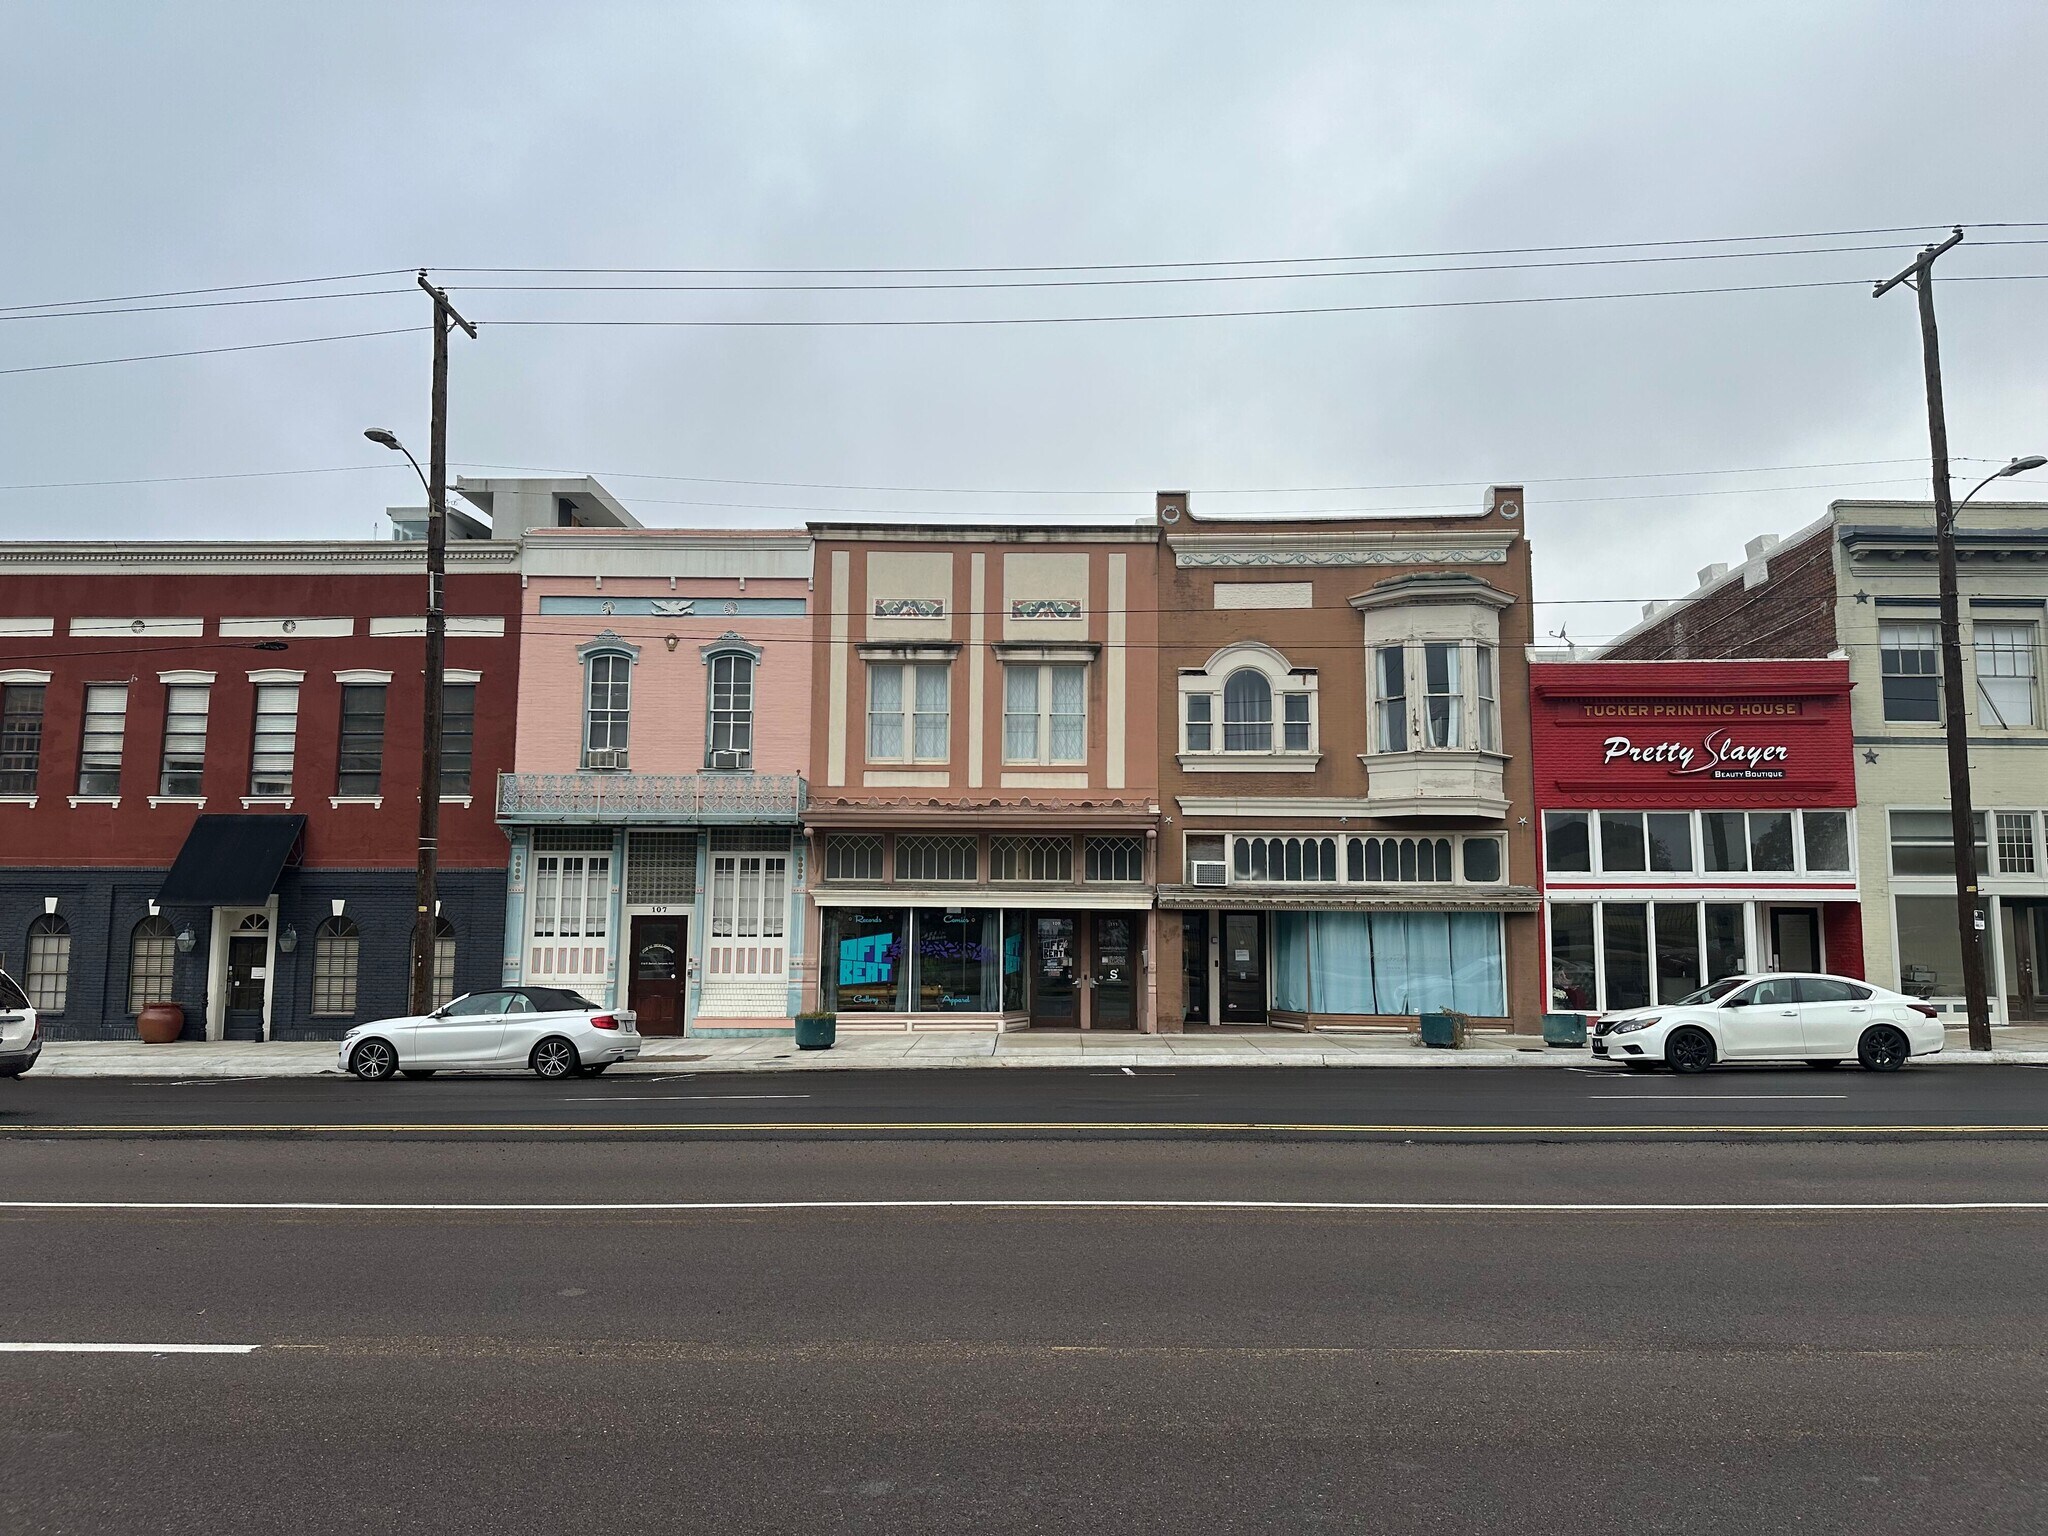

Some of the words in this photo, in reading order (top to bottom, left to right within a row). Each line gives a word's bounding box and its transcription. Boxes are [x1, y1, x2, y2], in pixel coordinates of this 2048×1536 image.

[1584, 705, 1649, 716] TUCKER
[1654, 704, 1735, 716] PRINTING
[1739, 703, 1796, 715] HOUSE
[1603, 736, 1695, 769] Pretty
[1668, 726, 1789, 775] Slayer
[855, 914, 882, 923] Records
[943, 914, 970, 924] Comics
[840, 932, 893, 962] OFF
[840, 960, 891, 985] BEAT
